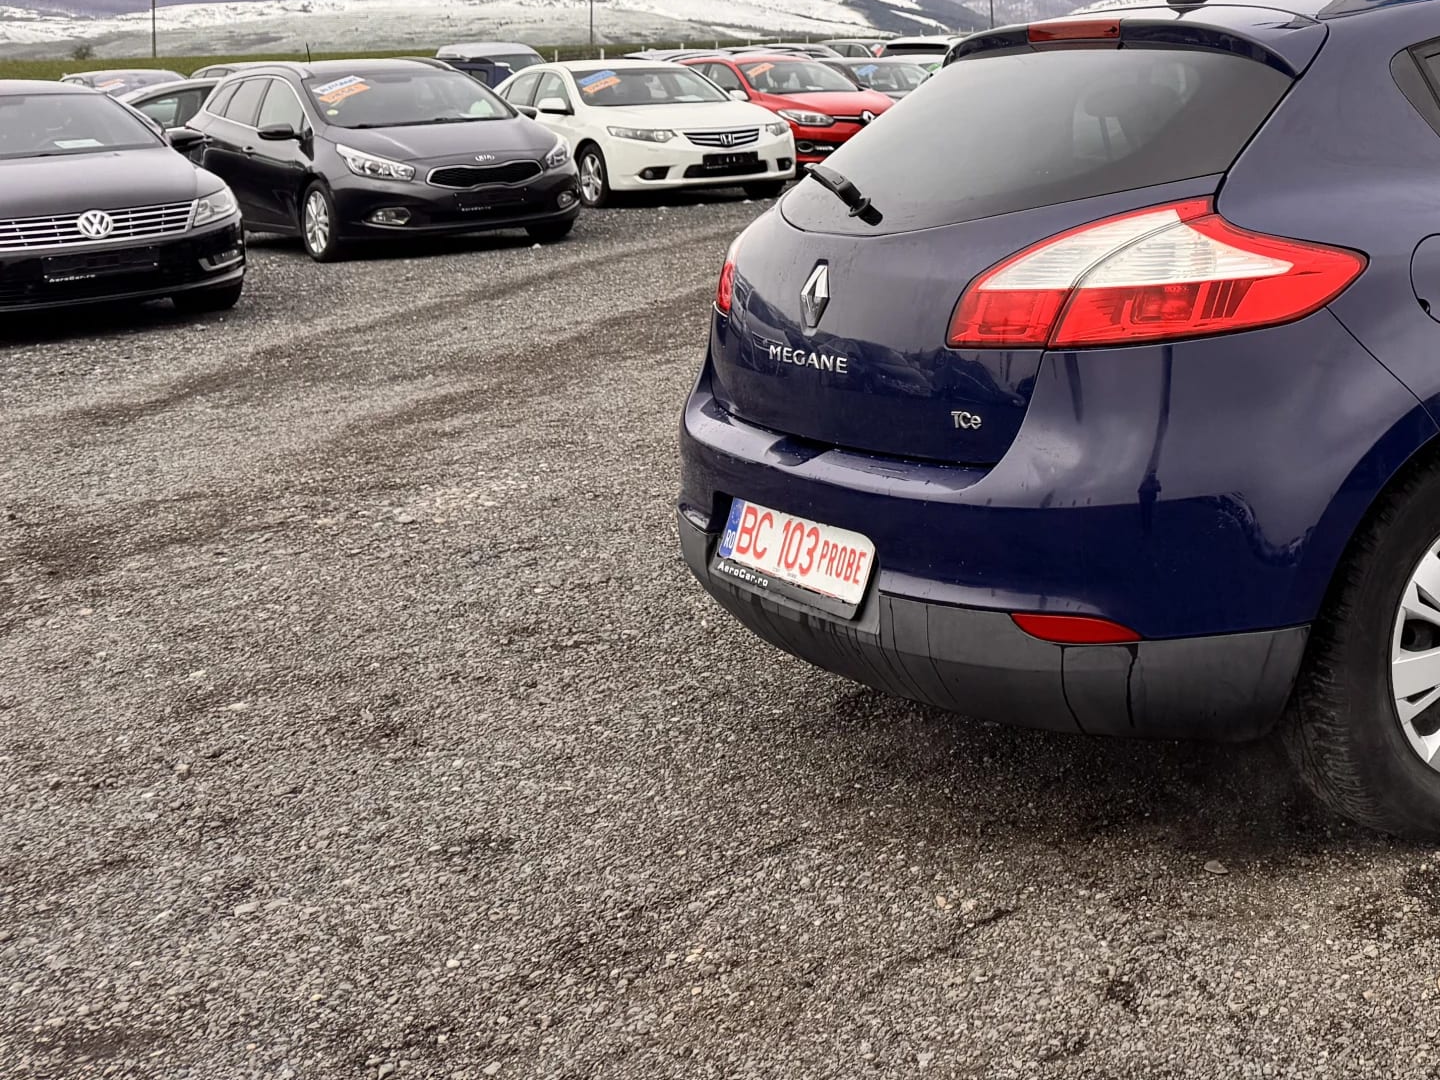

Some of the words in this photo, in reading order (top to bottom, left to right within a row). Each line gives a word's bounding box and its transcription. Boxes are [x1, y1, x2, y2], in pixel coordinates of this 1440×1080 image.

[768, 344, 849, 374] MEGANE
[951, 411, 983, 429] TCe
[724, 529, 736, 550] RO
[735, 504, 774, 561] BC
[776, 519, 821, 577] 103
[817, 539, 868, 585] PROBE
[717, 560, 769, 588] AeroCar.ro
